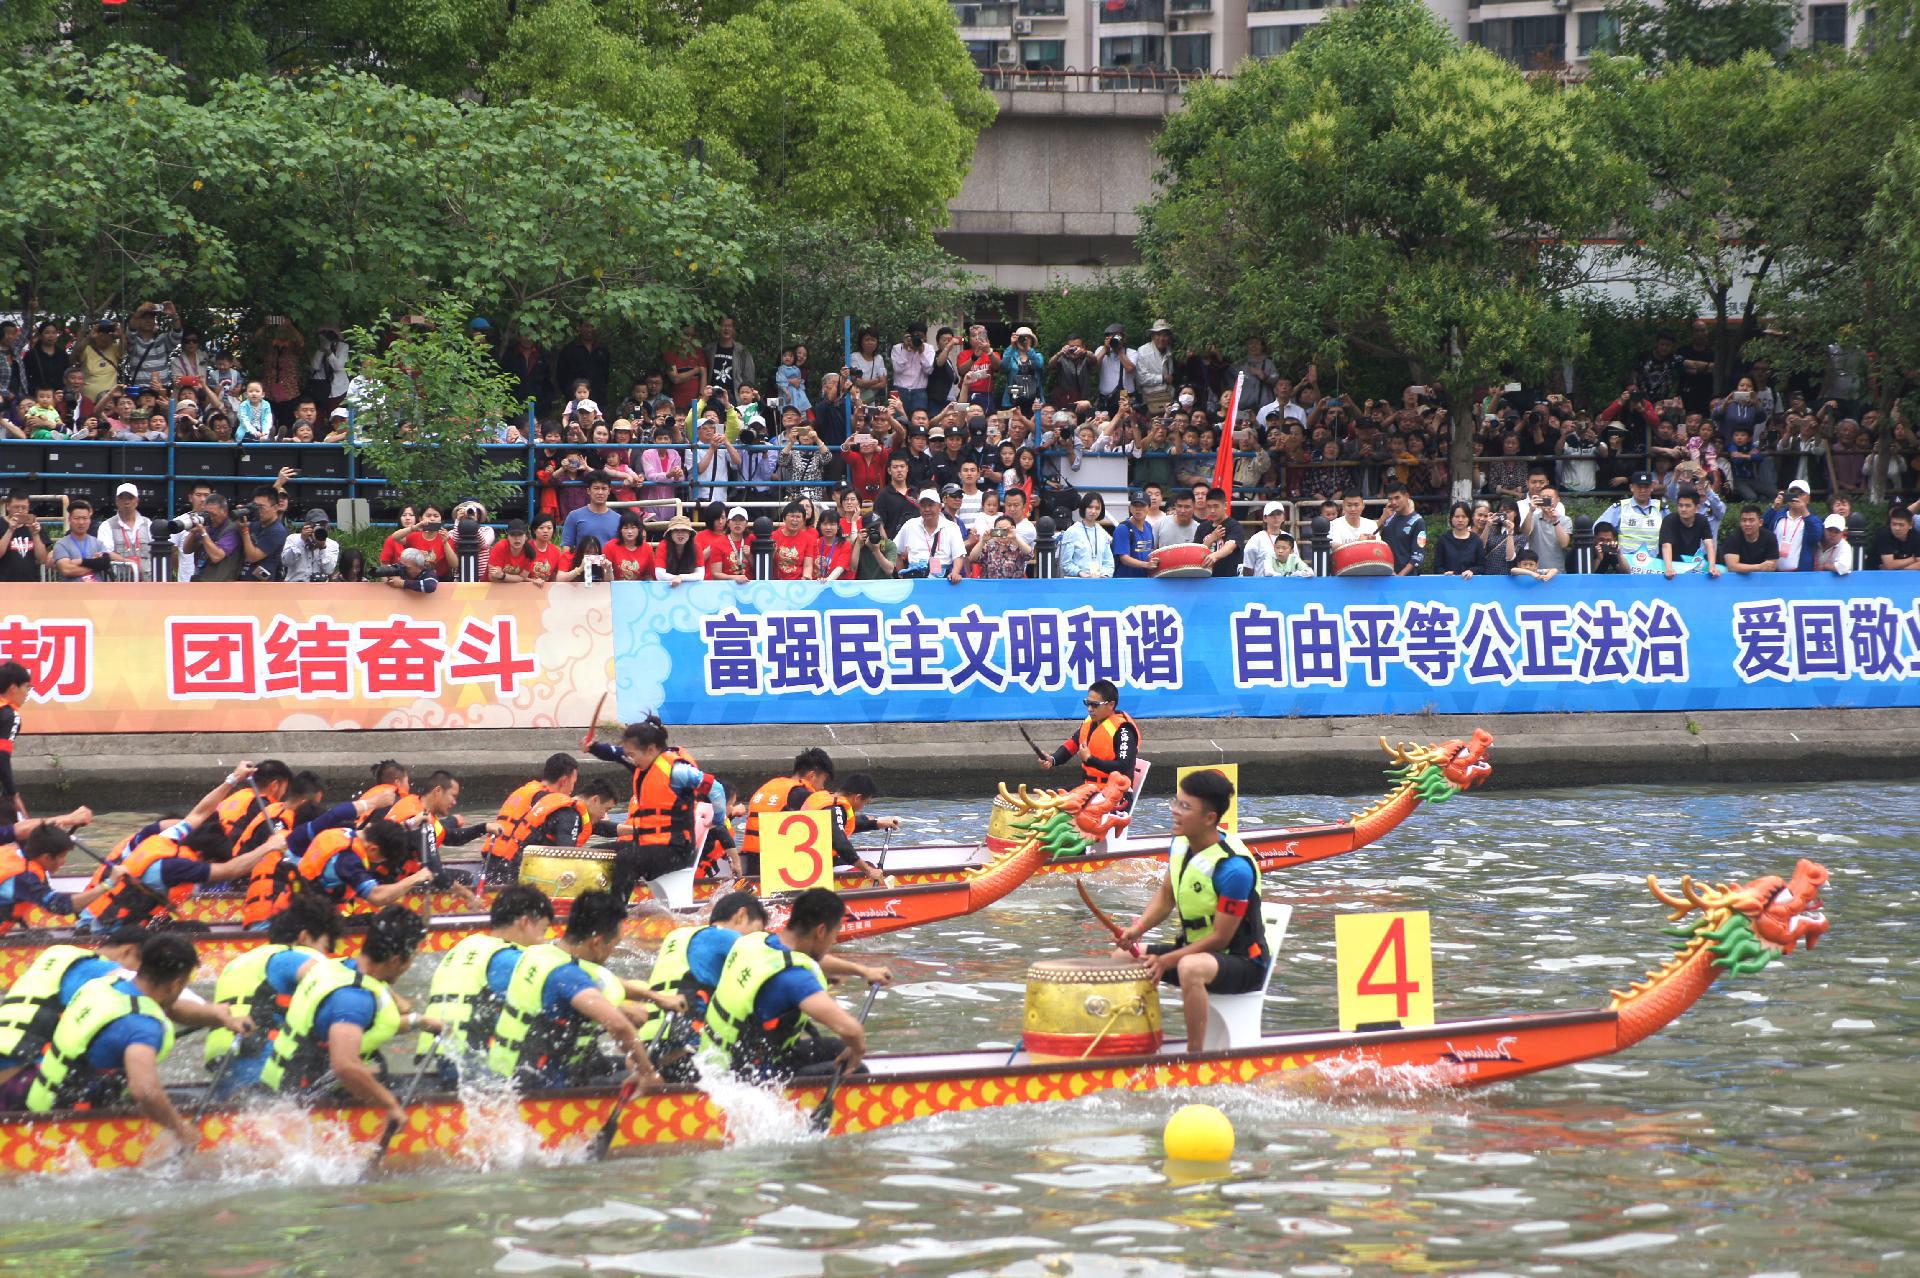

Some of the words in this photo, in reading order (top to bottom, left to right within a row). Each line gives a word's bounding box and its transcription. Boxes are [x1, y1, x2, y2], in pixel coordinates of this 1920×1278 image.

[171, 620, 535, 695] 团结奋斗
[705, 608, 1179, 689] 富强民主文明和谐
[1235, 606, 1687, 683] 自由平等公正法治
[778, 814, 823, 888] 3
[1357, 917, 1419, 1018] 4
